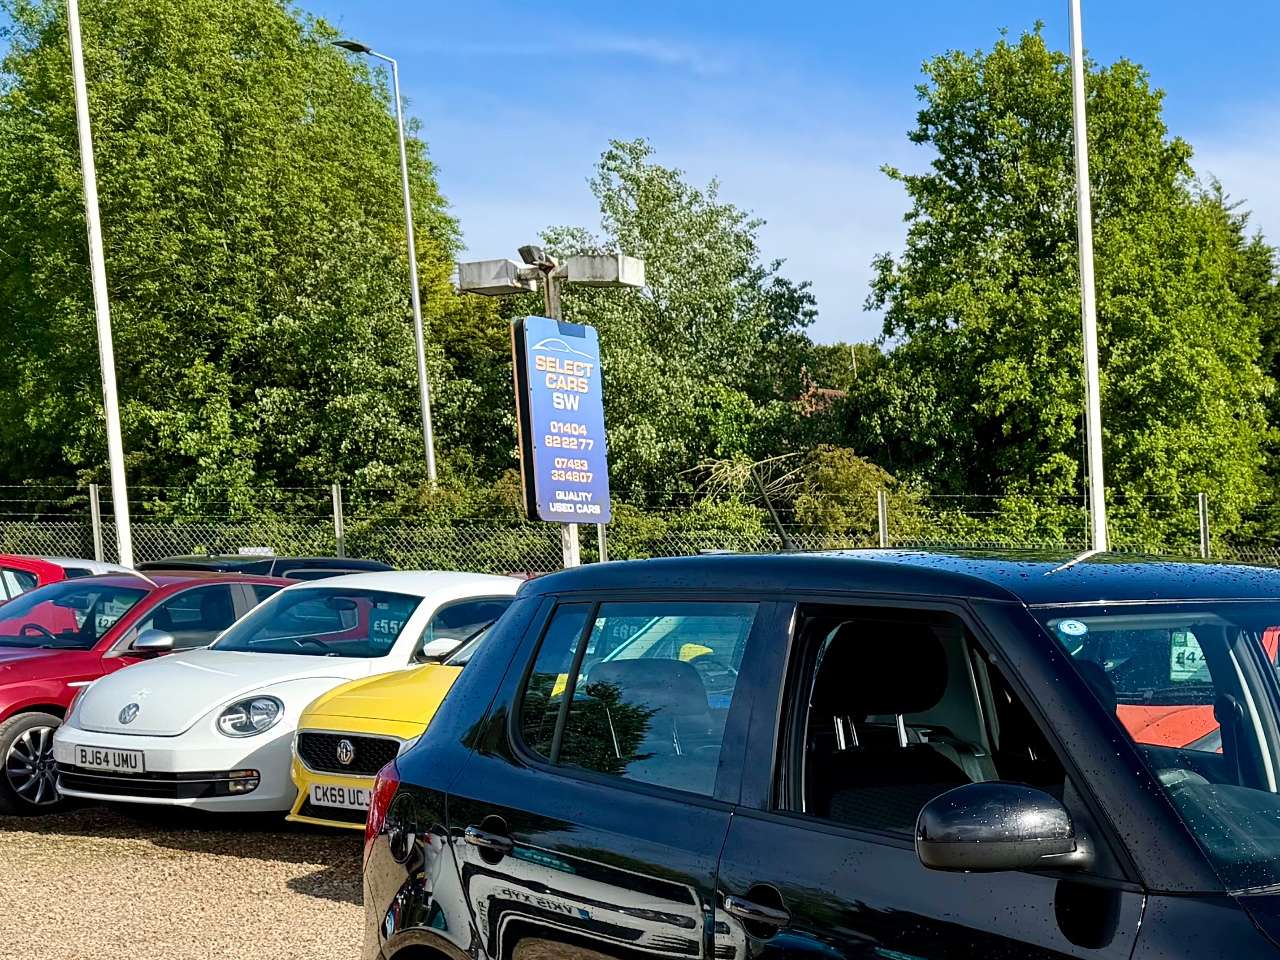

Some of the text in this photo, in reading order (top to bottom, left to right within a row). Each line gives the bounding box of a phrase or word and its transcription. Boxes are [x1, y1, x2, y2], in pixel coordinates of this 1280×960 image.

[535, 355, 593, 377] SELECT
[545, 373, 589, 394] CARS
[553, 392, 580, 411] SW
[550, 421, 587, 436] 01404
[556, 491, 592, 502] QUALITY
[549, 502, 601, 514] USED CARS
[80, 748, 137, 769] BJ64 UMU
[315, 785, 345, 804] CK69
